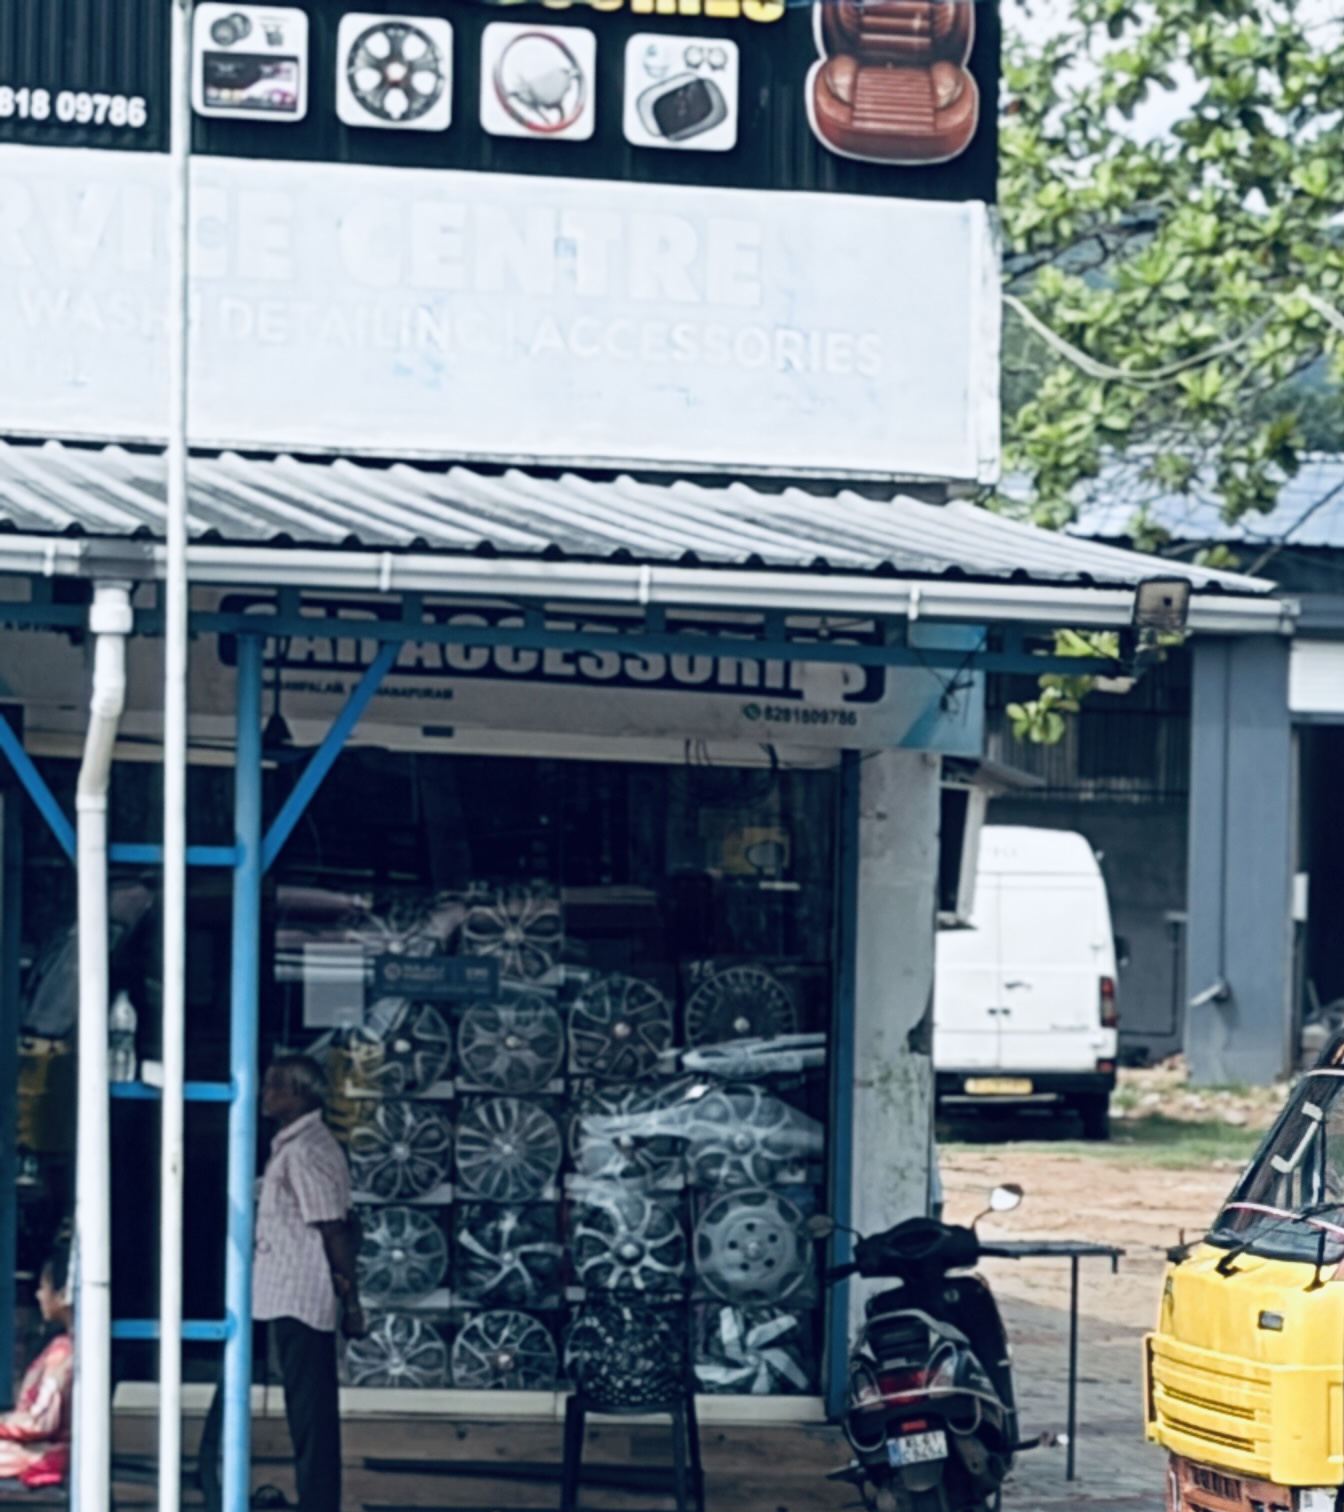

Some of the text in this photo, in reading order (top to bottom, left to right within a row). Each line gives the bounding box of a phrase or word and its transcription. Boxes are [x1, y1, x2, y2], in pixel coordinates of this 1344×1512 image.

[56, 91, 147, 127] 09786
[338, 191, 761, 307] CENTRE
[220, 297, 494, 357] DETAILING
[530, 314, 885, 377] ACCESSORIES
[243, 603, 380, 665] AR
